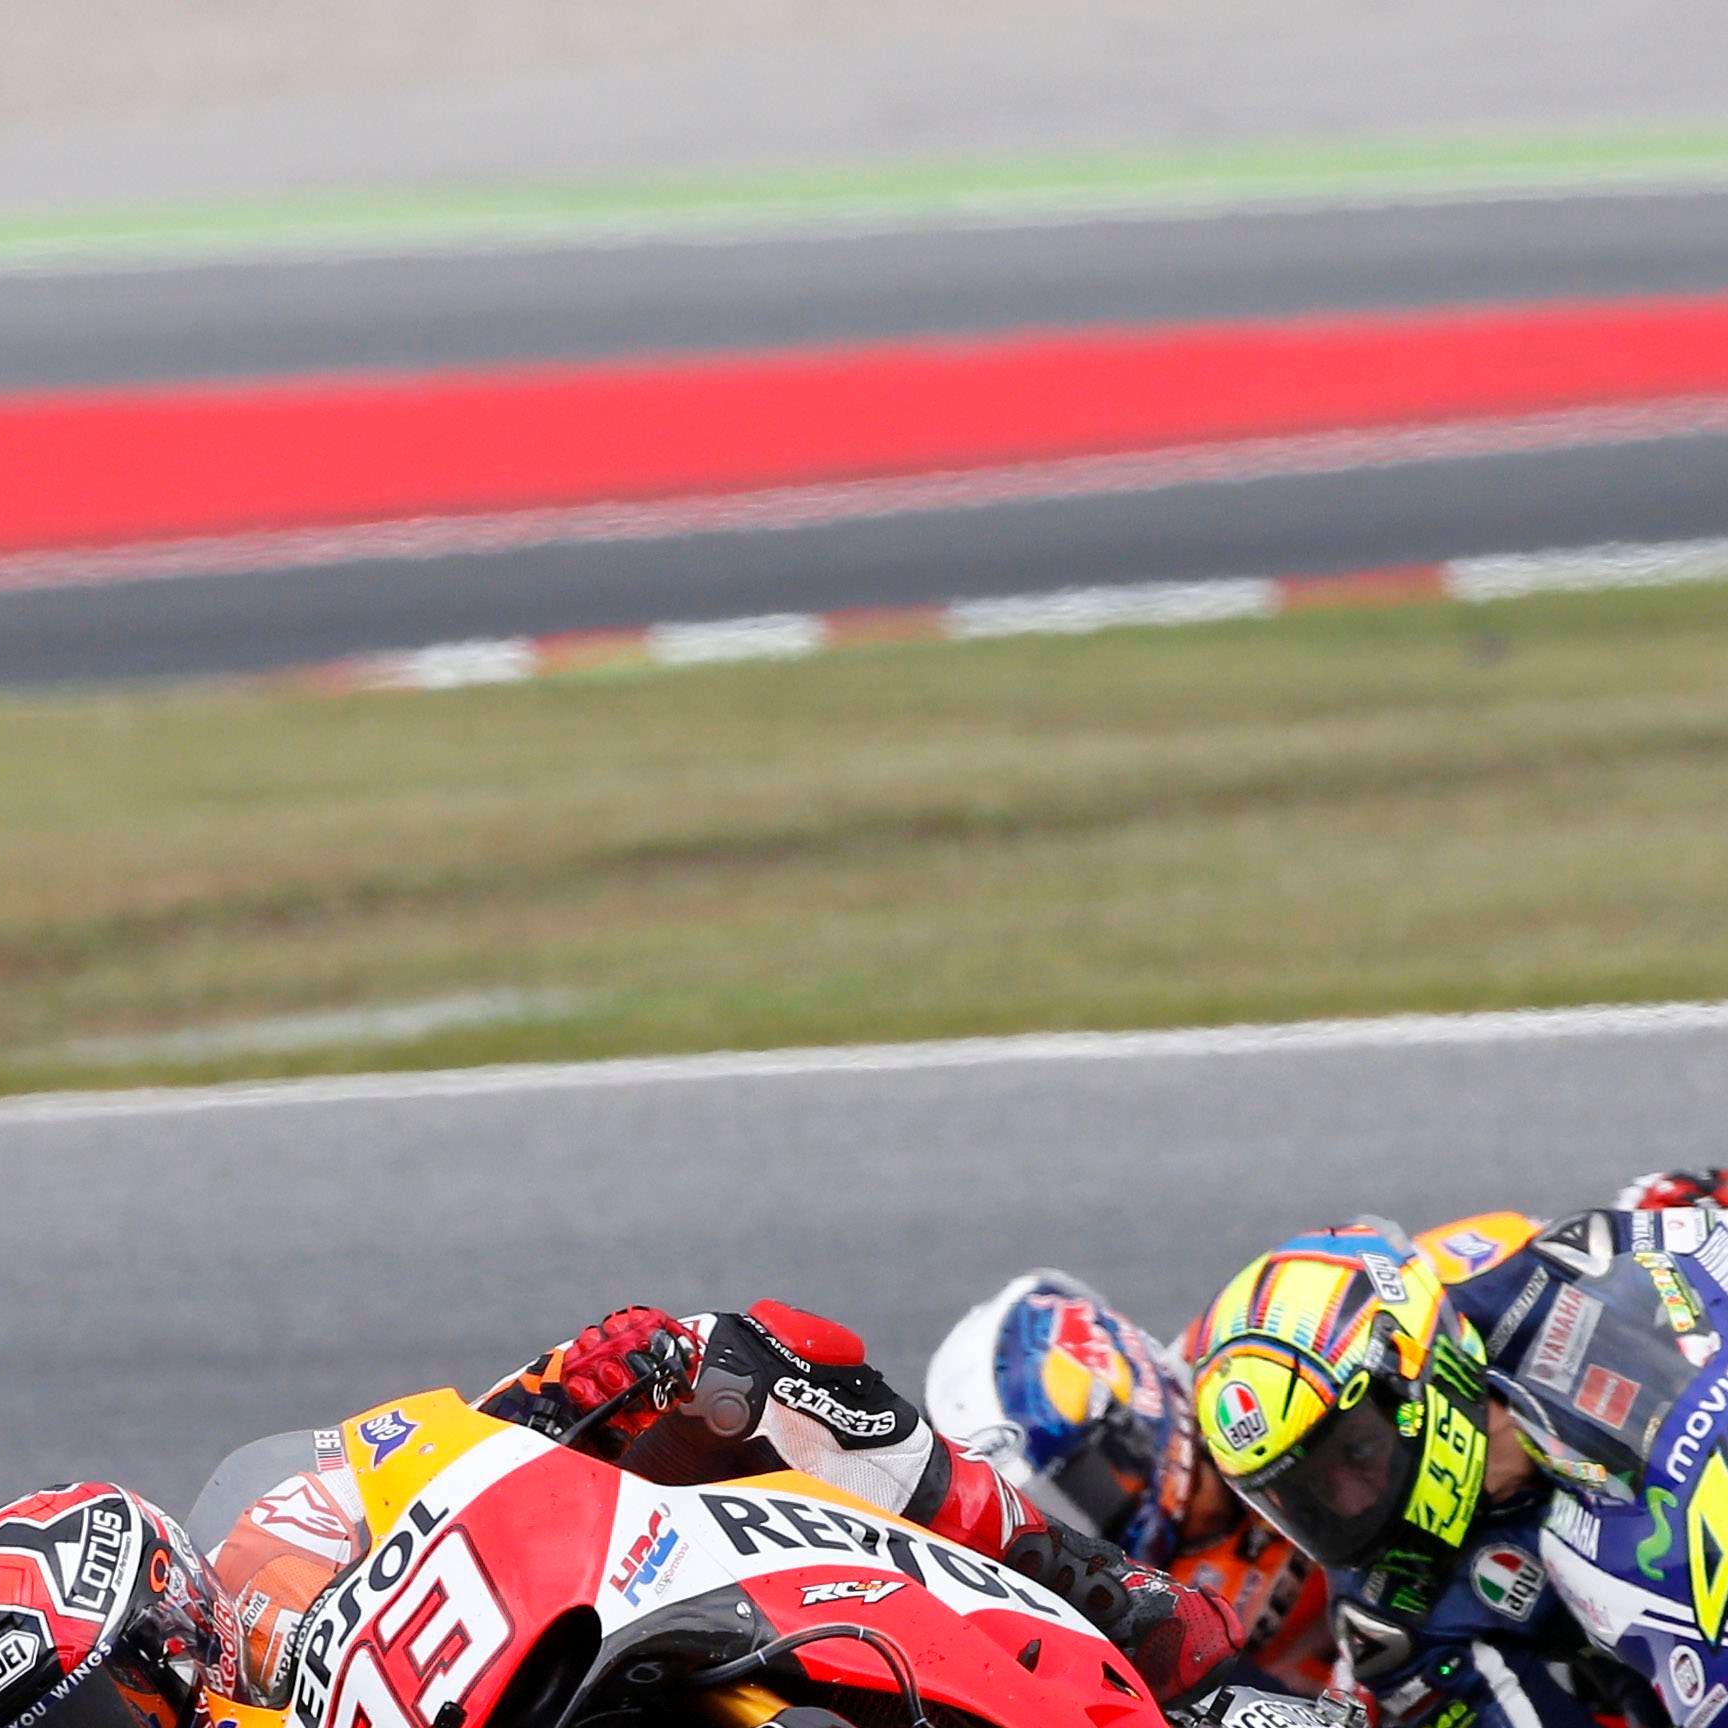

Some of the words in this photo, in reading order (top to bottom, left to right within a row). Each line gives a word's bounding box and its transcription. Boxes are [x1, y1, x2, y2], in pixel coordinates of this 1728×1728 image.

[1418, 1403, 1476, 1540] 46
[72, 1509, 123, 1610] LOTUS
[609, 1509, 680, 1608] HRC
[50, 1641, 113, 1701] WINGS
